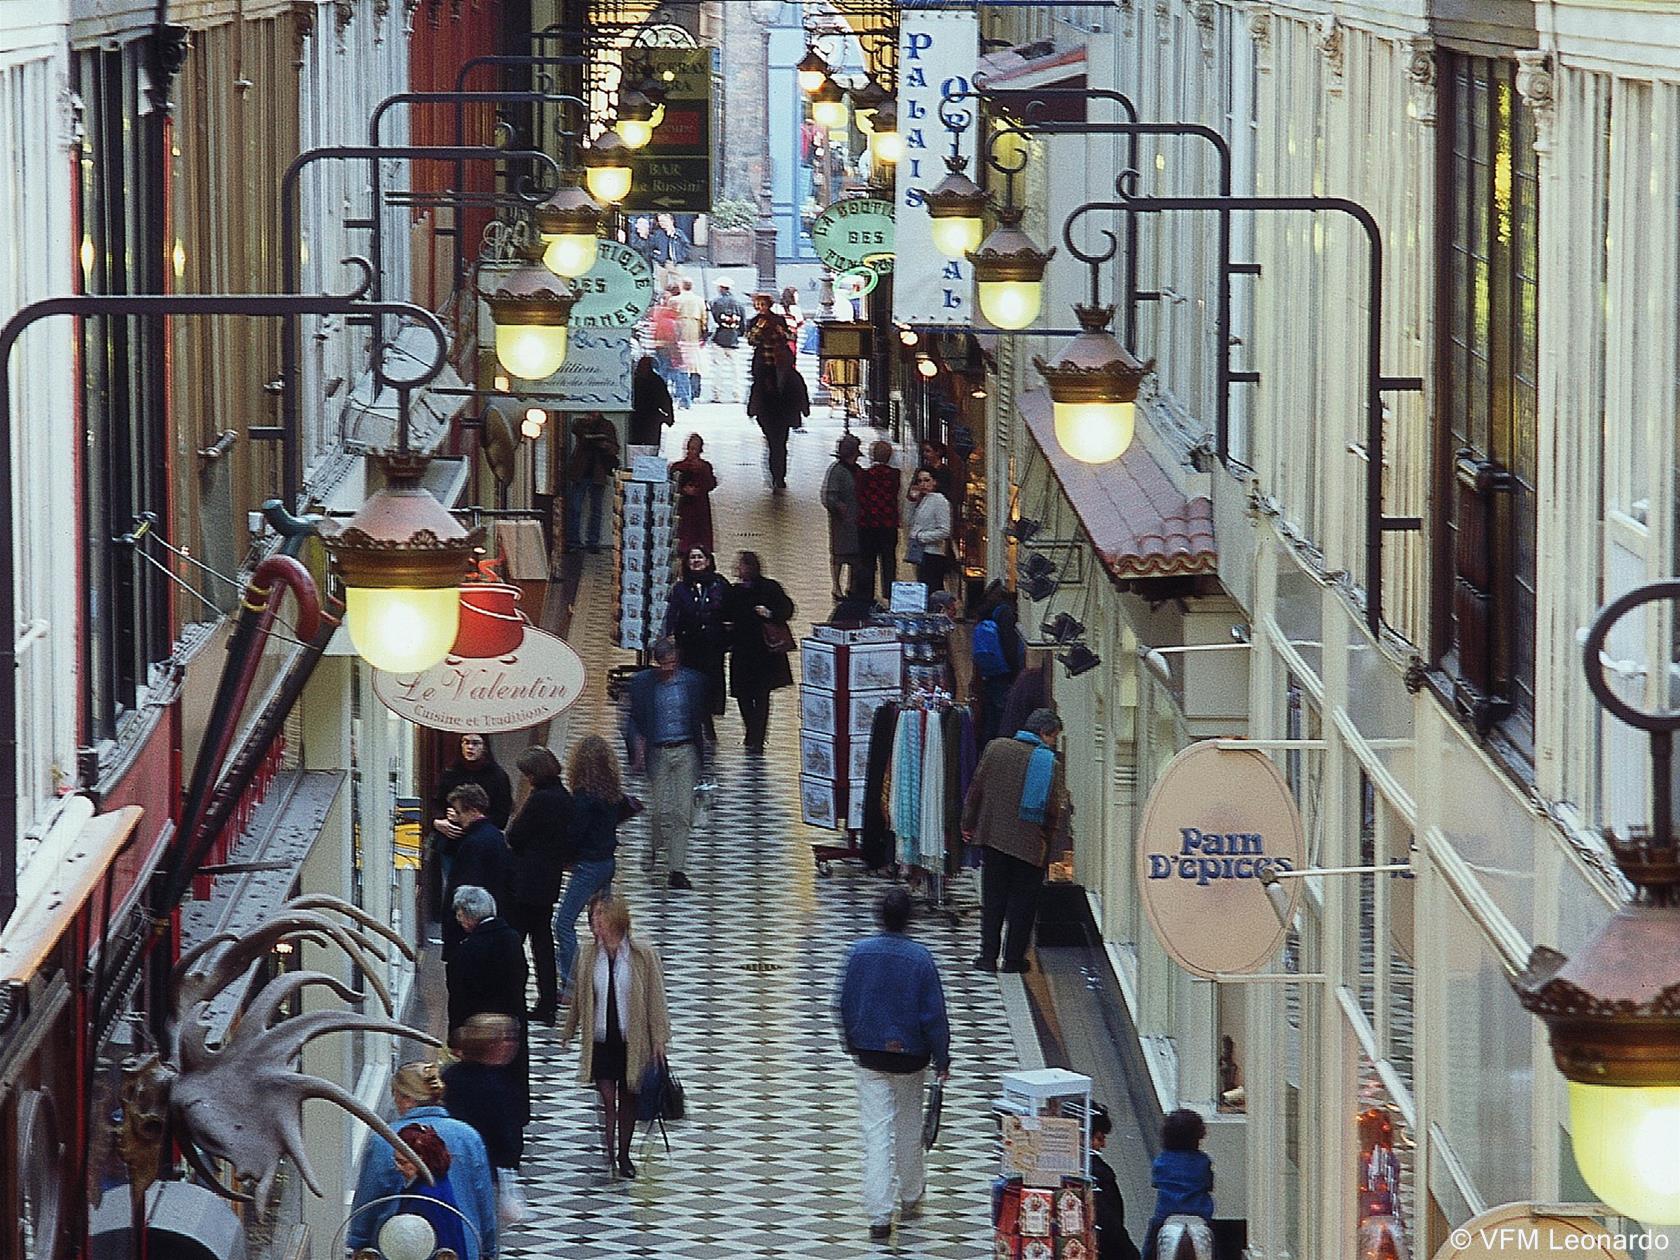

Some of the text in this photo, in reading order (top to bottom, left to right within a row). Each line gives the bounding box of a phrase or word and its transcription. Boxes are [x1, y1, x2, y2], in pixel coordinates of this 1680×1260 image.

[903, 32, 934, 208] PALAIS
[650, 162, 682, 176] BAR
[814, 214, 835, 237] LA
[848, 231, 884, 244] DES
[393, 668, 568, 702] Le Valentin
[413, 704, 549, 727] Cuisine et Traditions
[1180, 827, 1264, 856] Pain
